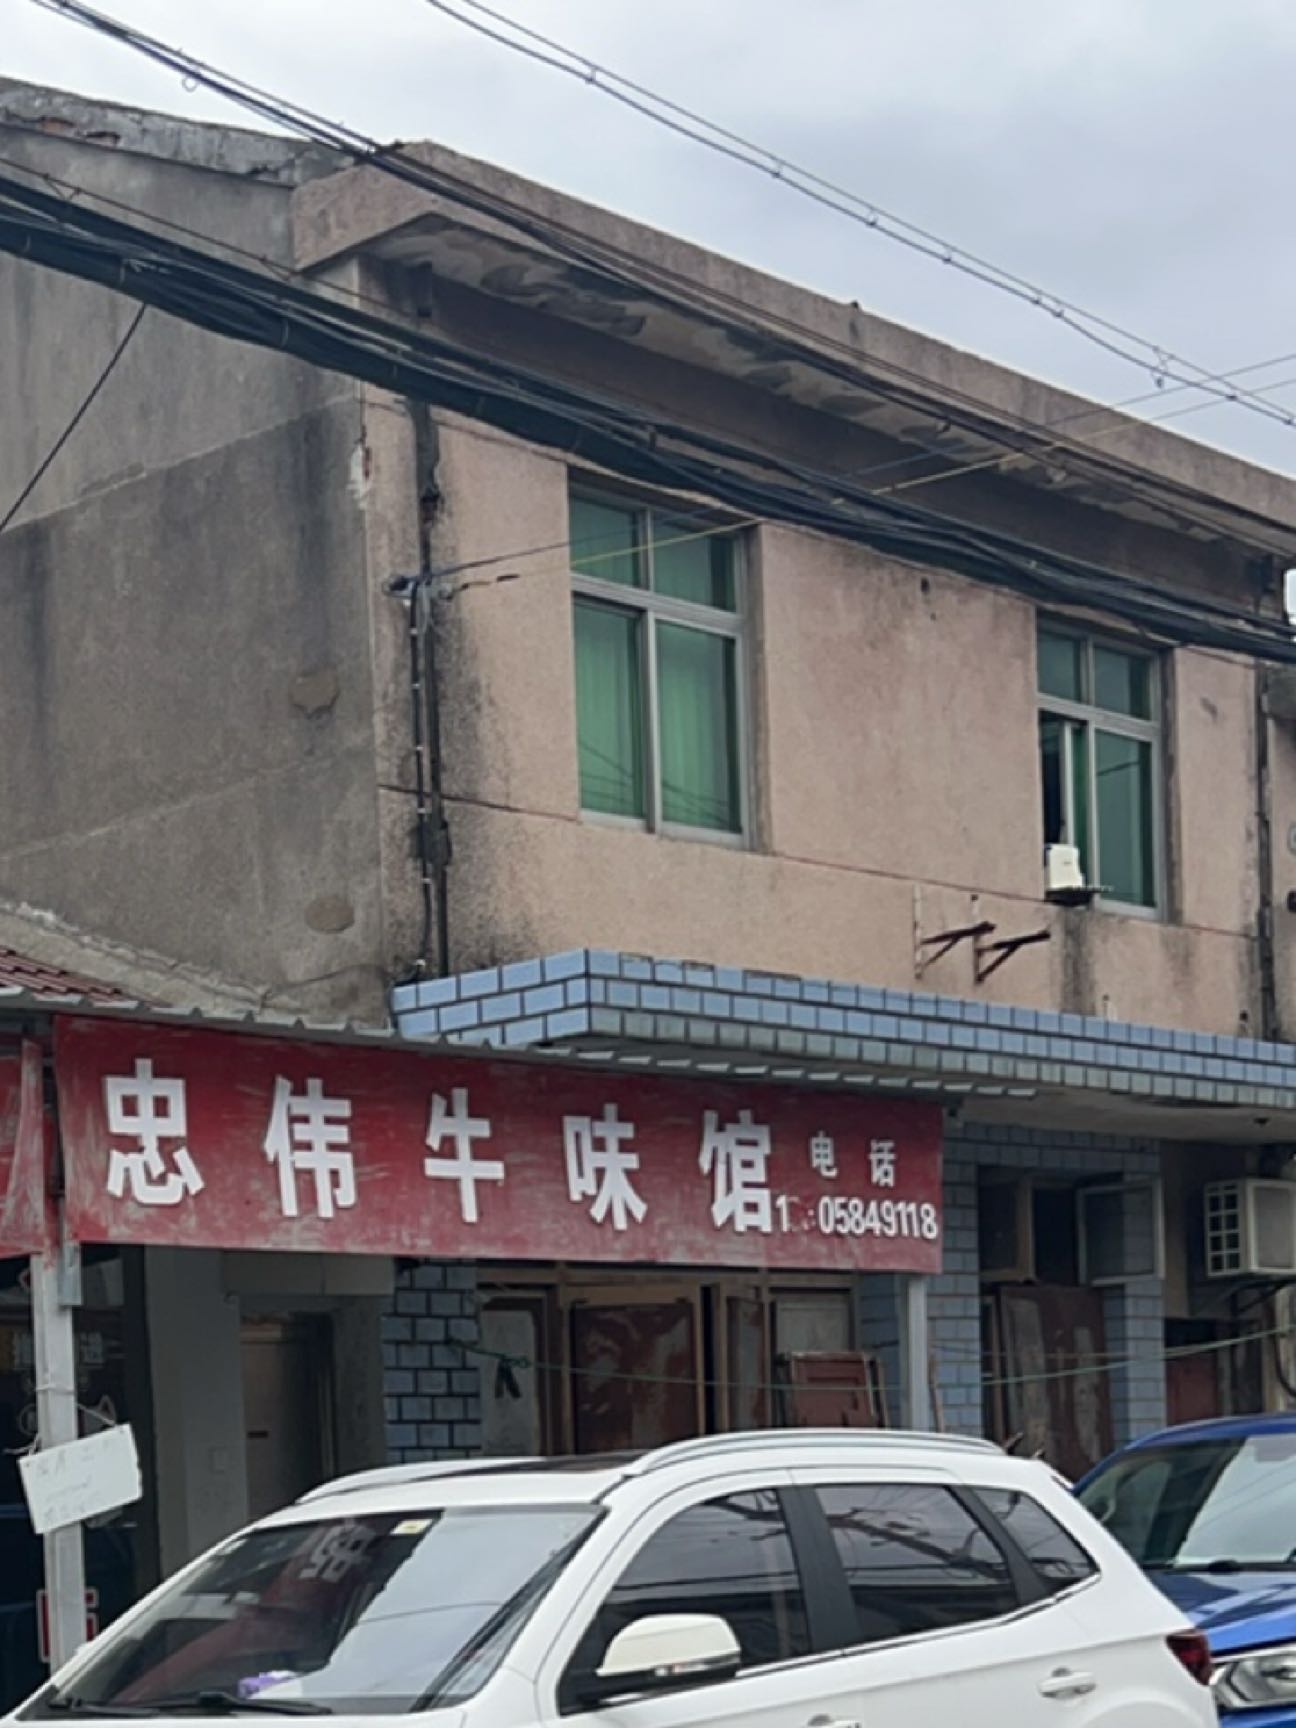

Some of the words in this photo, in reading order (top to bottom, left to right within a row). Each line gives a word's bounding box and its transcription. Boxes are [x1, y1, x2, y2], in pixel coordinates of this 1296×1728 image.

[104, 1058, 773, 1232] 忠伟牛味馆
[809, 1130, 898, 1187] 电话
